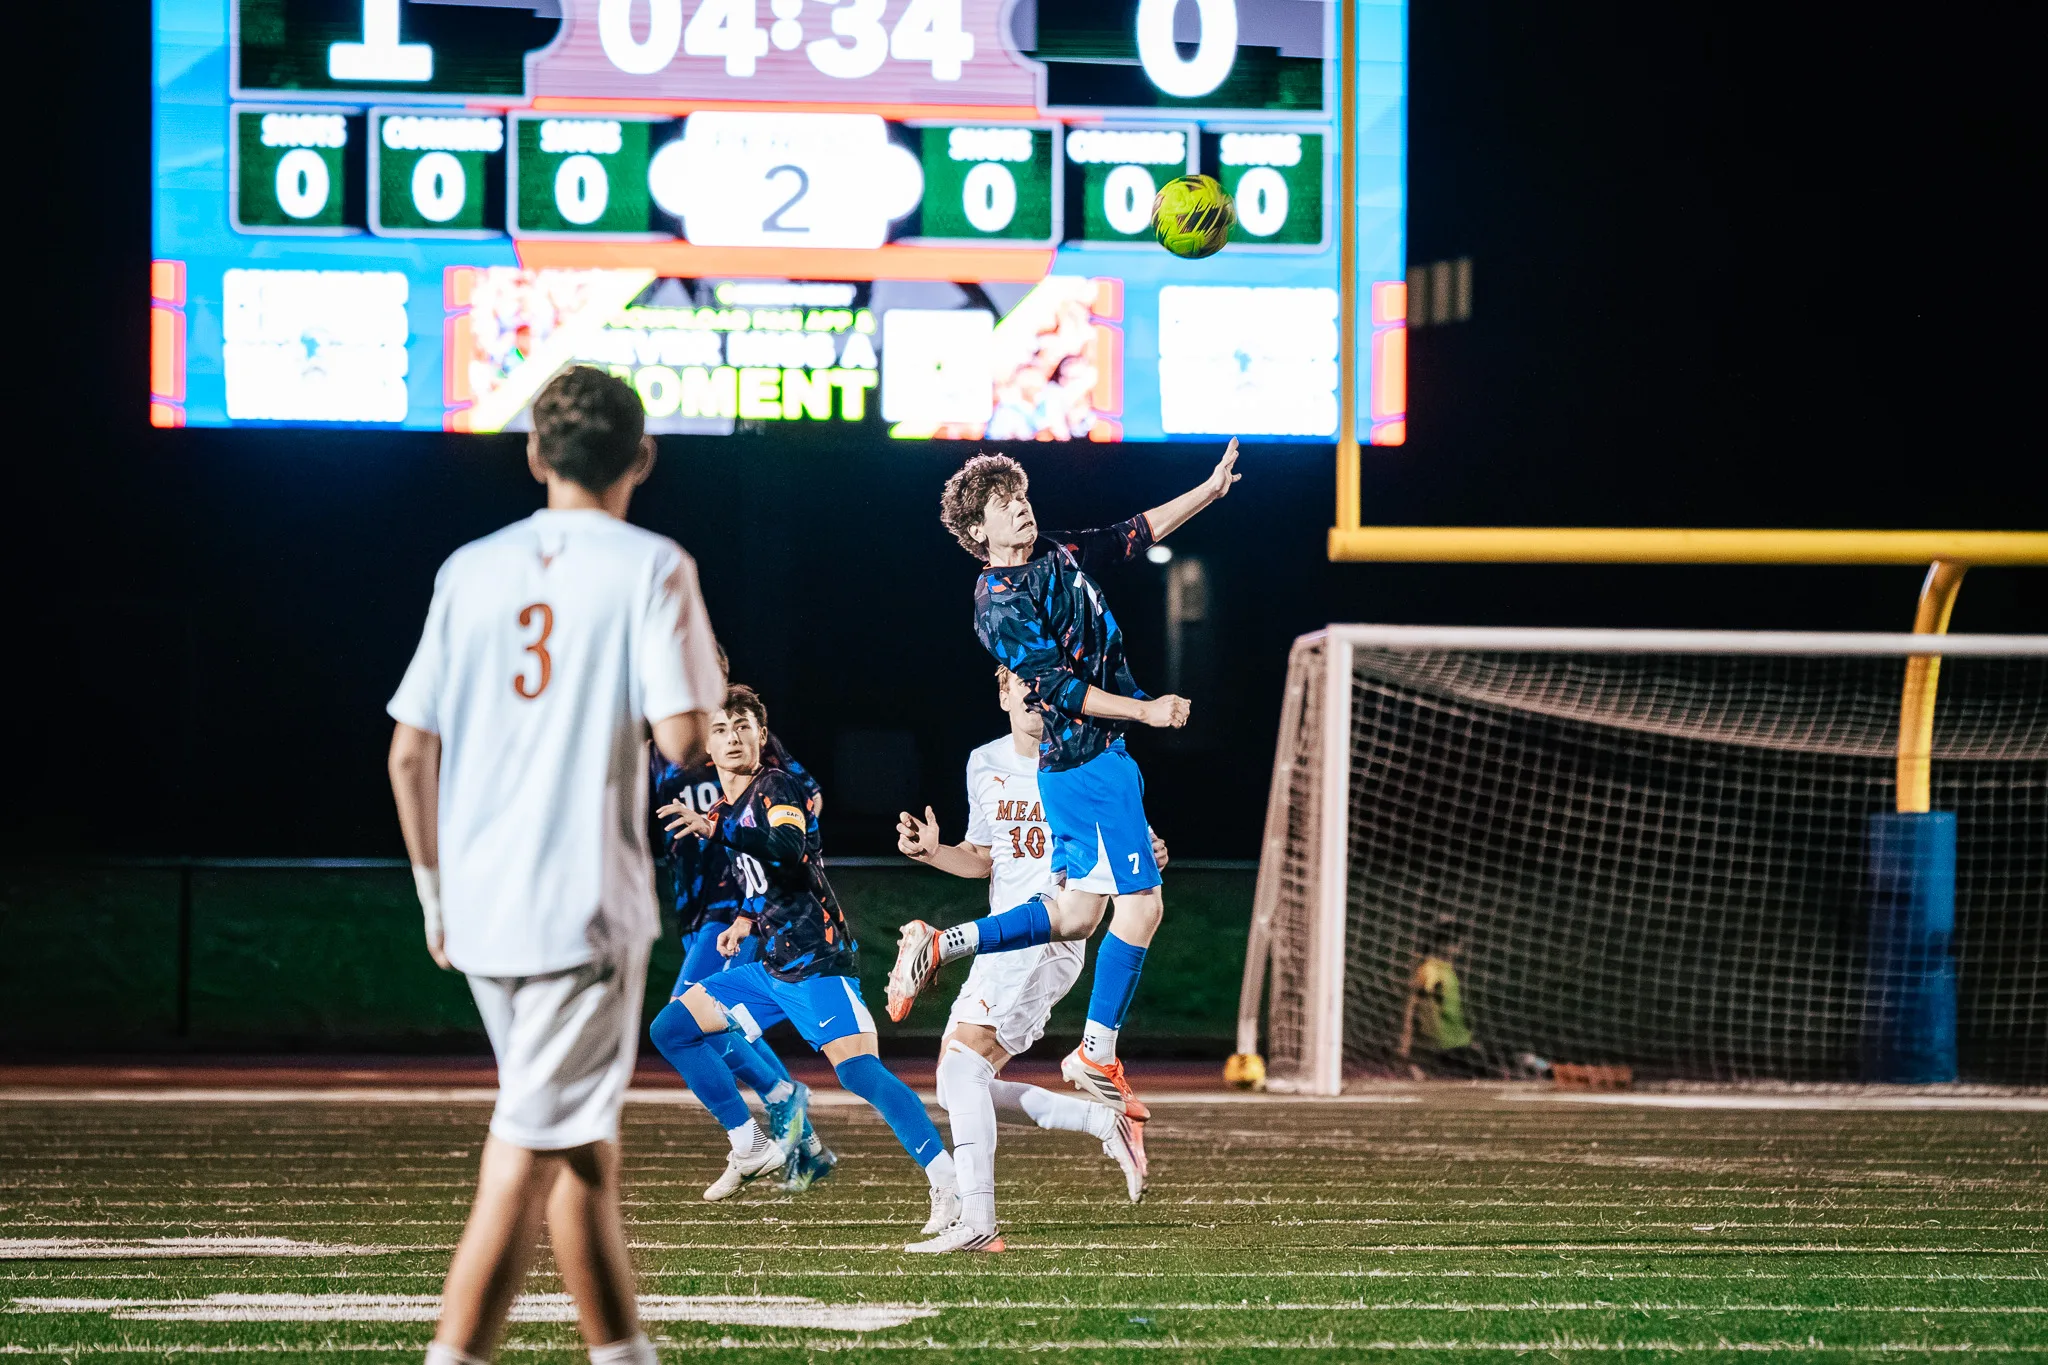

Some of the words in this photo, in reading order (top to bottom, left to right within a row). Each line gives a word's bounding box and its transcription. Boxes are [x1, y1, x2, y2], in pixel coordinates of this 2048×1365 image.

[328, 0, 433, 81] 1
[597, 0, 975, 82] 04:34
[1135, 0, 1238, 97] 0
[278, 151, 327, 216] 0
[414, 154, 463, 220] 0
[557, 157, 606, 222] 0
[762, 164, 810, 233] 2
[965, 164, 1014, 230] 0
[1104, 165, 1155, 235] 0
[1237, 169, 1286, 234] 0
[608, 364, 878, 421] OMENT
[513, 603, 554, 699] 3
[995, 800, 1048, 822] MEA
[1009, 826, 1046, 859] 10
[736, 853, 768, 899] 10
[1128, 853, 1140, 875] 7
